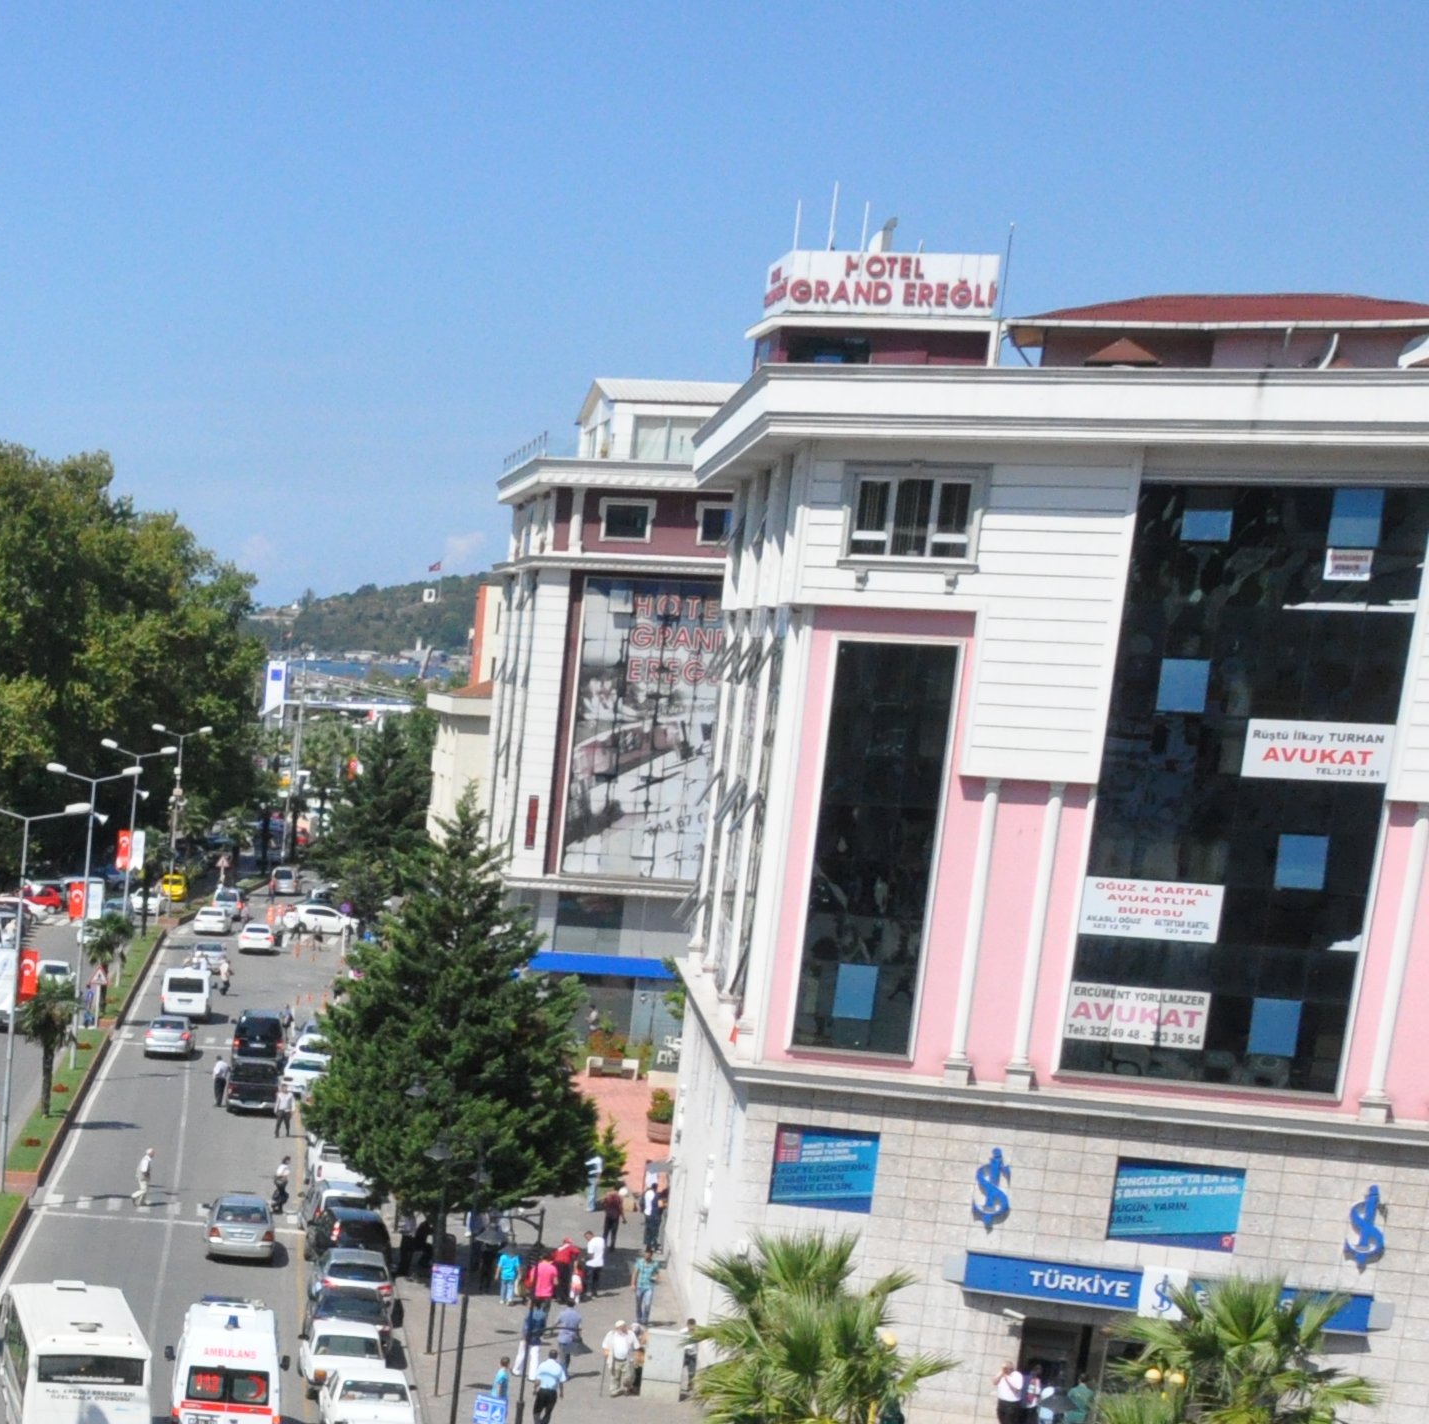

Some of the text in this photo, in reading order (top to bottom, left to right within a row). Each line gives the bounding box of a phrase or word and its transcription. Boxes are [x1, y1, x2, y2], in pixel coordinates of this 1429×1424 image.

[846, 255, 925, 280] HOTEL
[790, 278, 893, 307] GRAND
[902, 278, 997, 310] EREĞLİ
[1253, 730, 1385, 744] Rüştü İlkay TURHAN
[1262, 747, 1374, 766] AVUKAT
[1096, 882, 1136, 892] OĞUZ
[1154, 886, 1213, 898] KARTAL
[1107, 894, 1197, 906] AVUKATLIK
[1074, 986, 1205, 1006] ERCÜMENT YORULMAZER
[1072, 1001, 1202, 1028] AVUKAT
[1090, 1025, 1109, 1038] 322
[1112, 1028, 1124, 1039] 49
[1127, 1029, 1140, 1040] 48
[1188, 1034, 1200, 1045] 54
[1029, 1268, 1132, 1300] TÜRKİYE
[203, 1347, 257, 1360] AMBULANS
